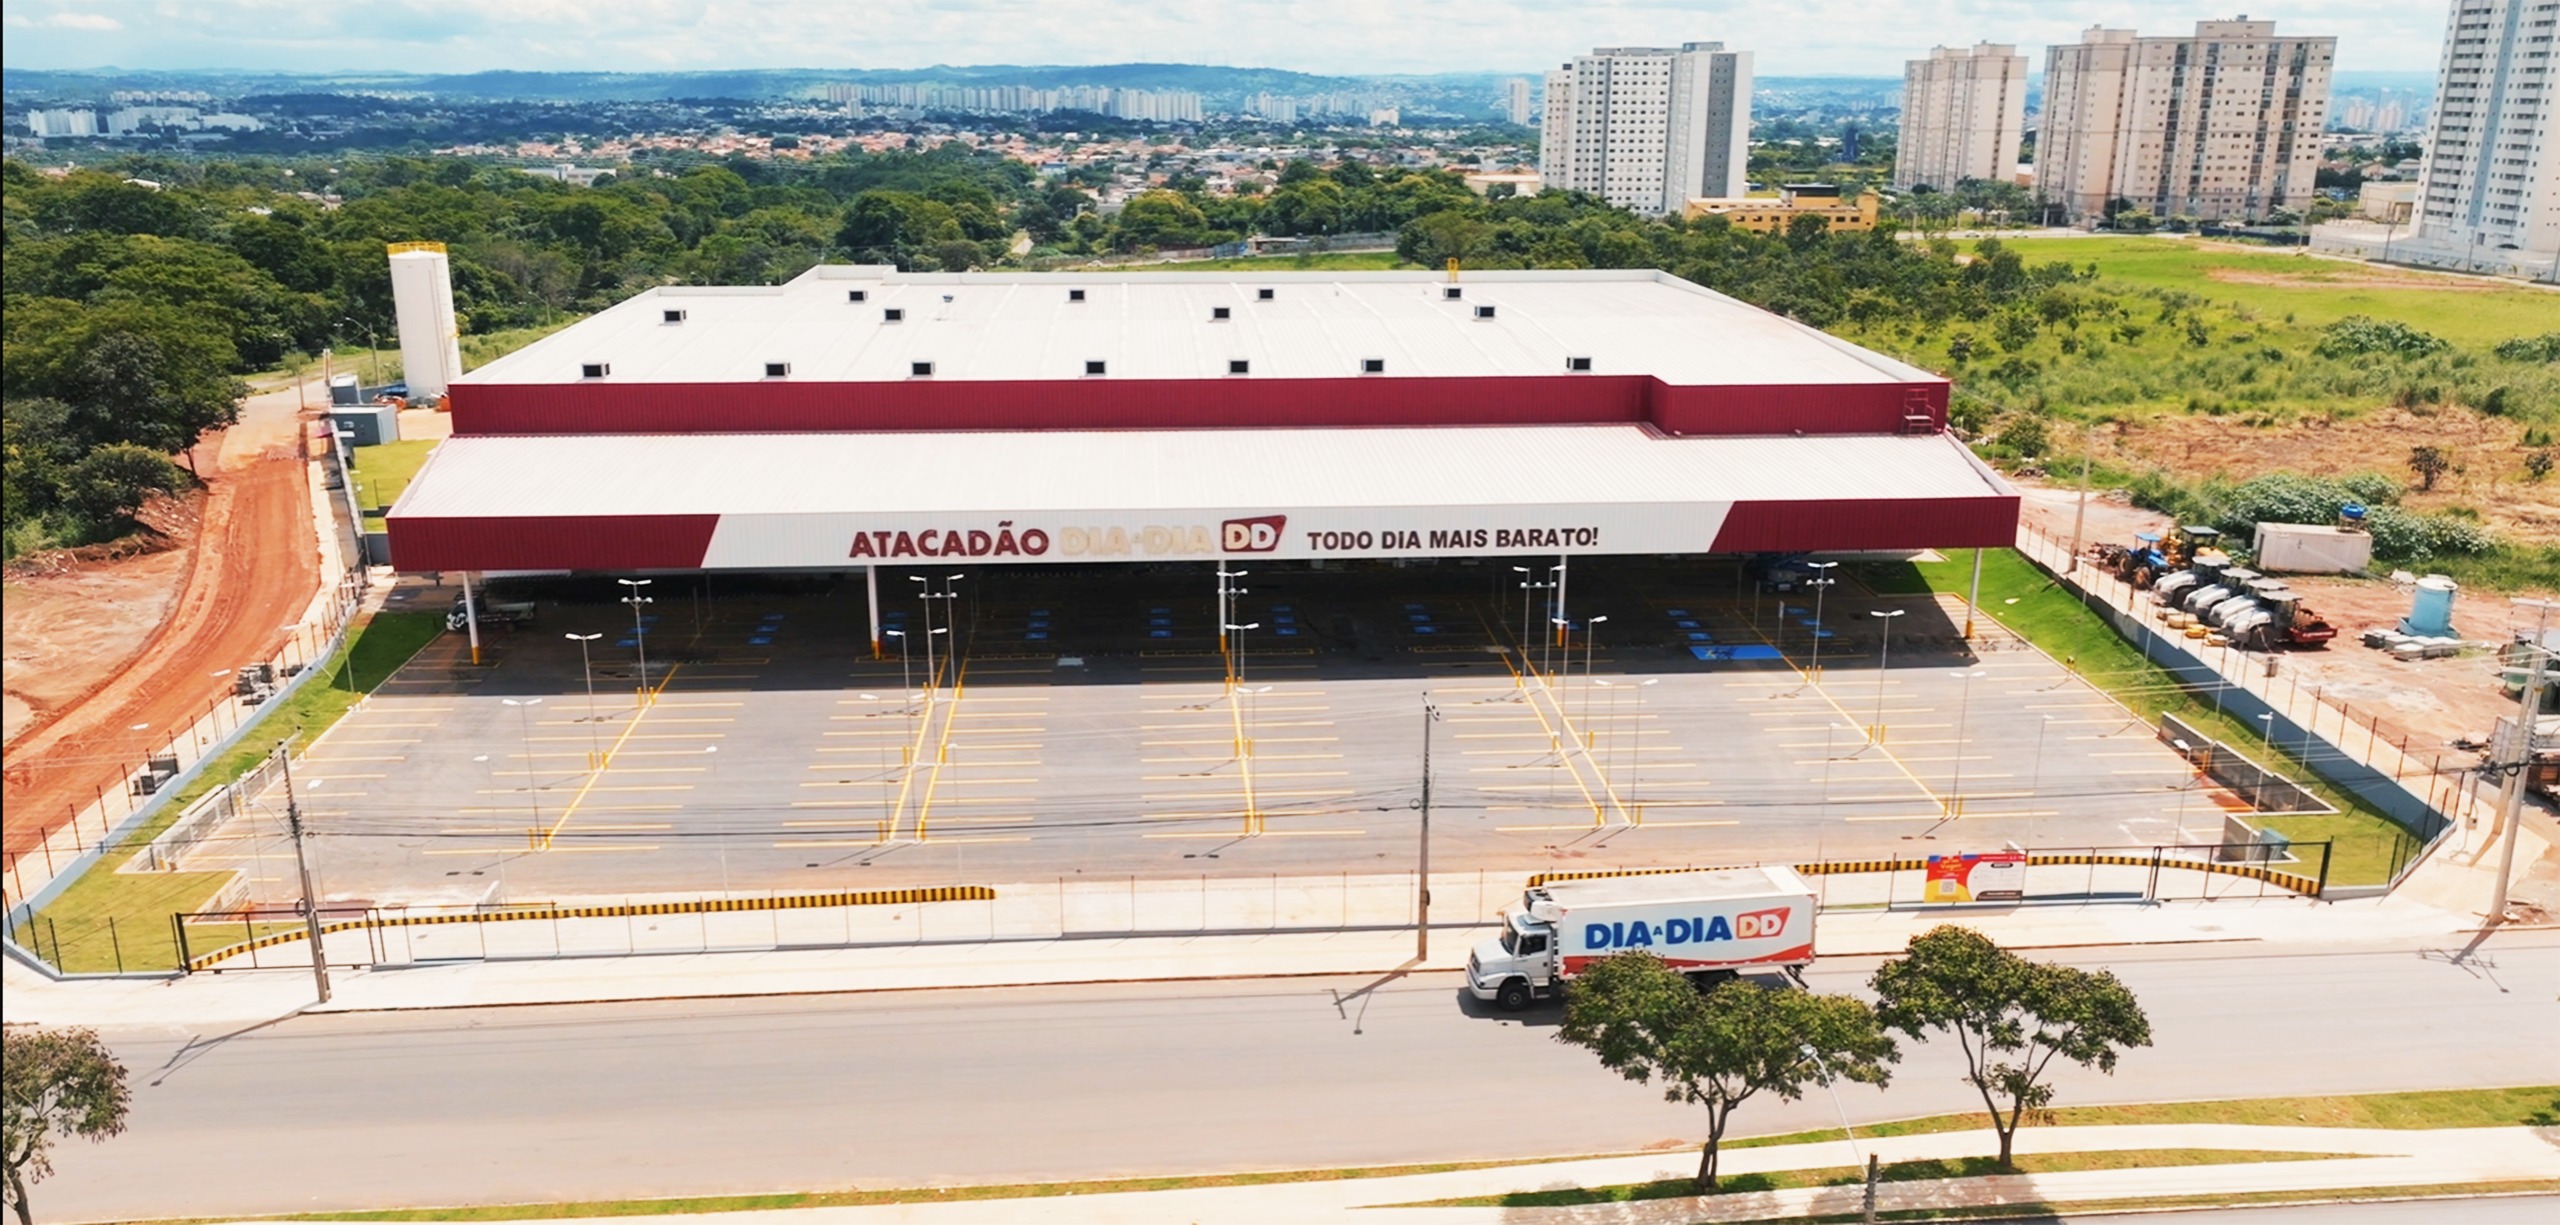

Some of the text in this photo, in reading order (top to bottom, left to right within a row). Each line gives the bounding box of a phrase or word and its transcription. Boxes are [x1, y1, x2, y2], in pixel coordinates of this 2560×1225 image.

[849, 521, 1049, 558] ATACADÃO
[1060, 526, 1132, 556] DIA
[1142, 525, 1214, 555] DIA
[1225, 523, 1276, 550] DD
[1307, 527, 1598, 550] TODO DIA MAIS BARATO!
[1585, 914, 1782, 949] DIA A DIA DD
